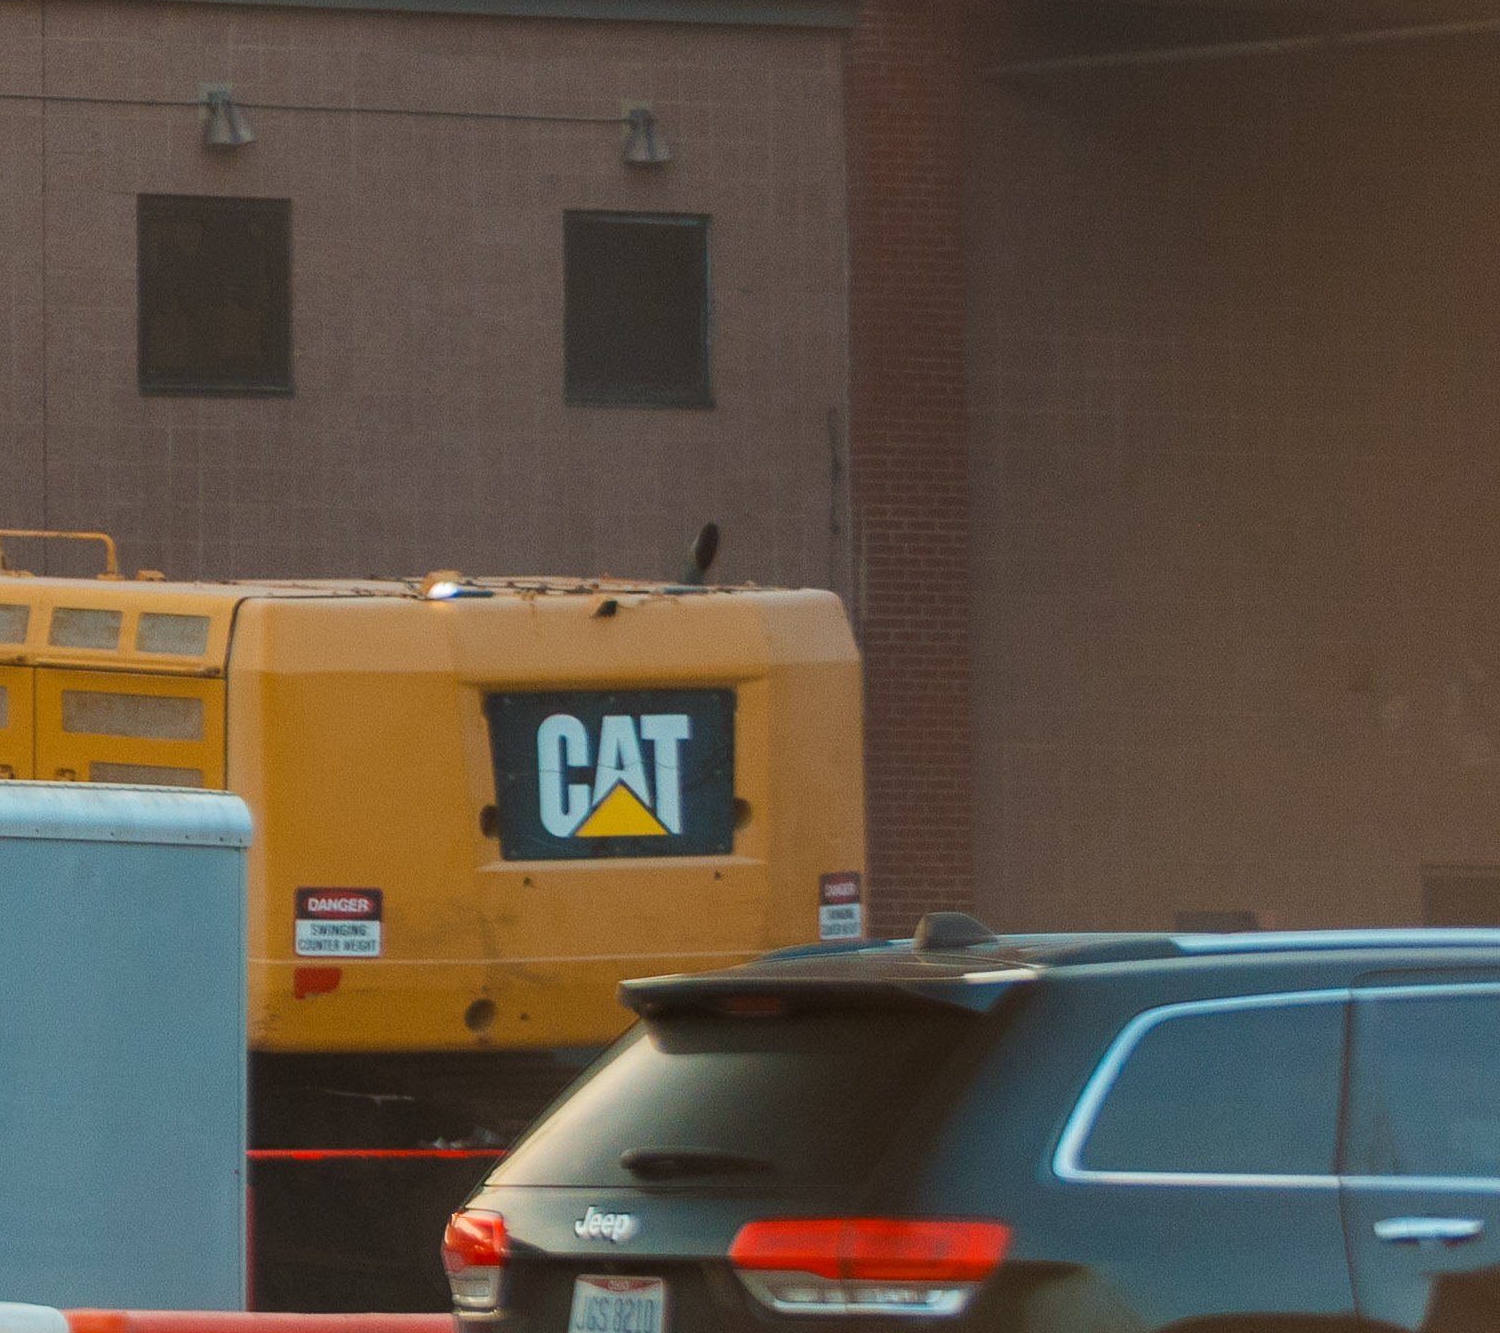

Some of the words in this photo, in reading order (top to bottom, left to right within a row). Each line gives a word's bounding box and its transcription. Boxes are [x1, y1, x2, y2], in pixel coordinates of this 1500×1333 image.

[537, 714, 690, 838] CAT
[308, 898, 369, 912] DANGER
[310, 924, 367, 936] SWINGING
[574, 1205, 631, 1242] Jeep
